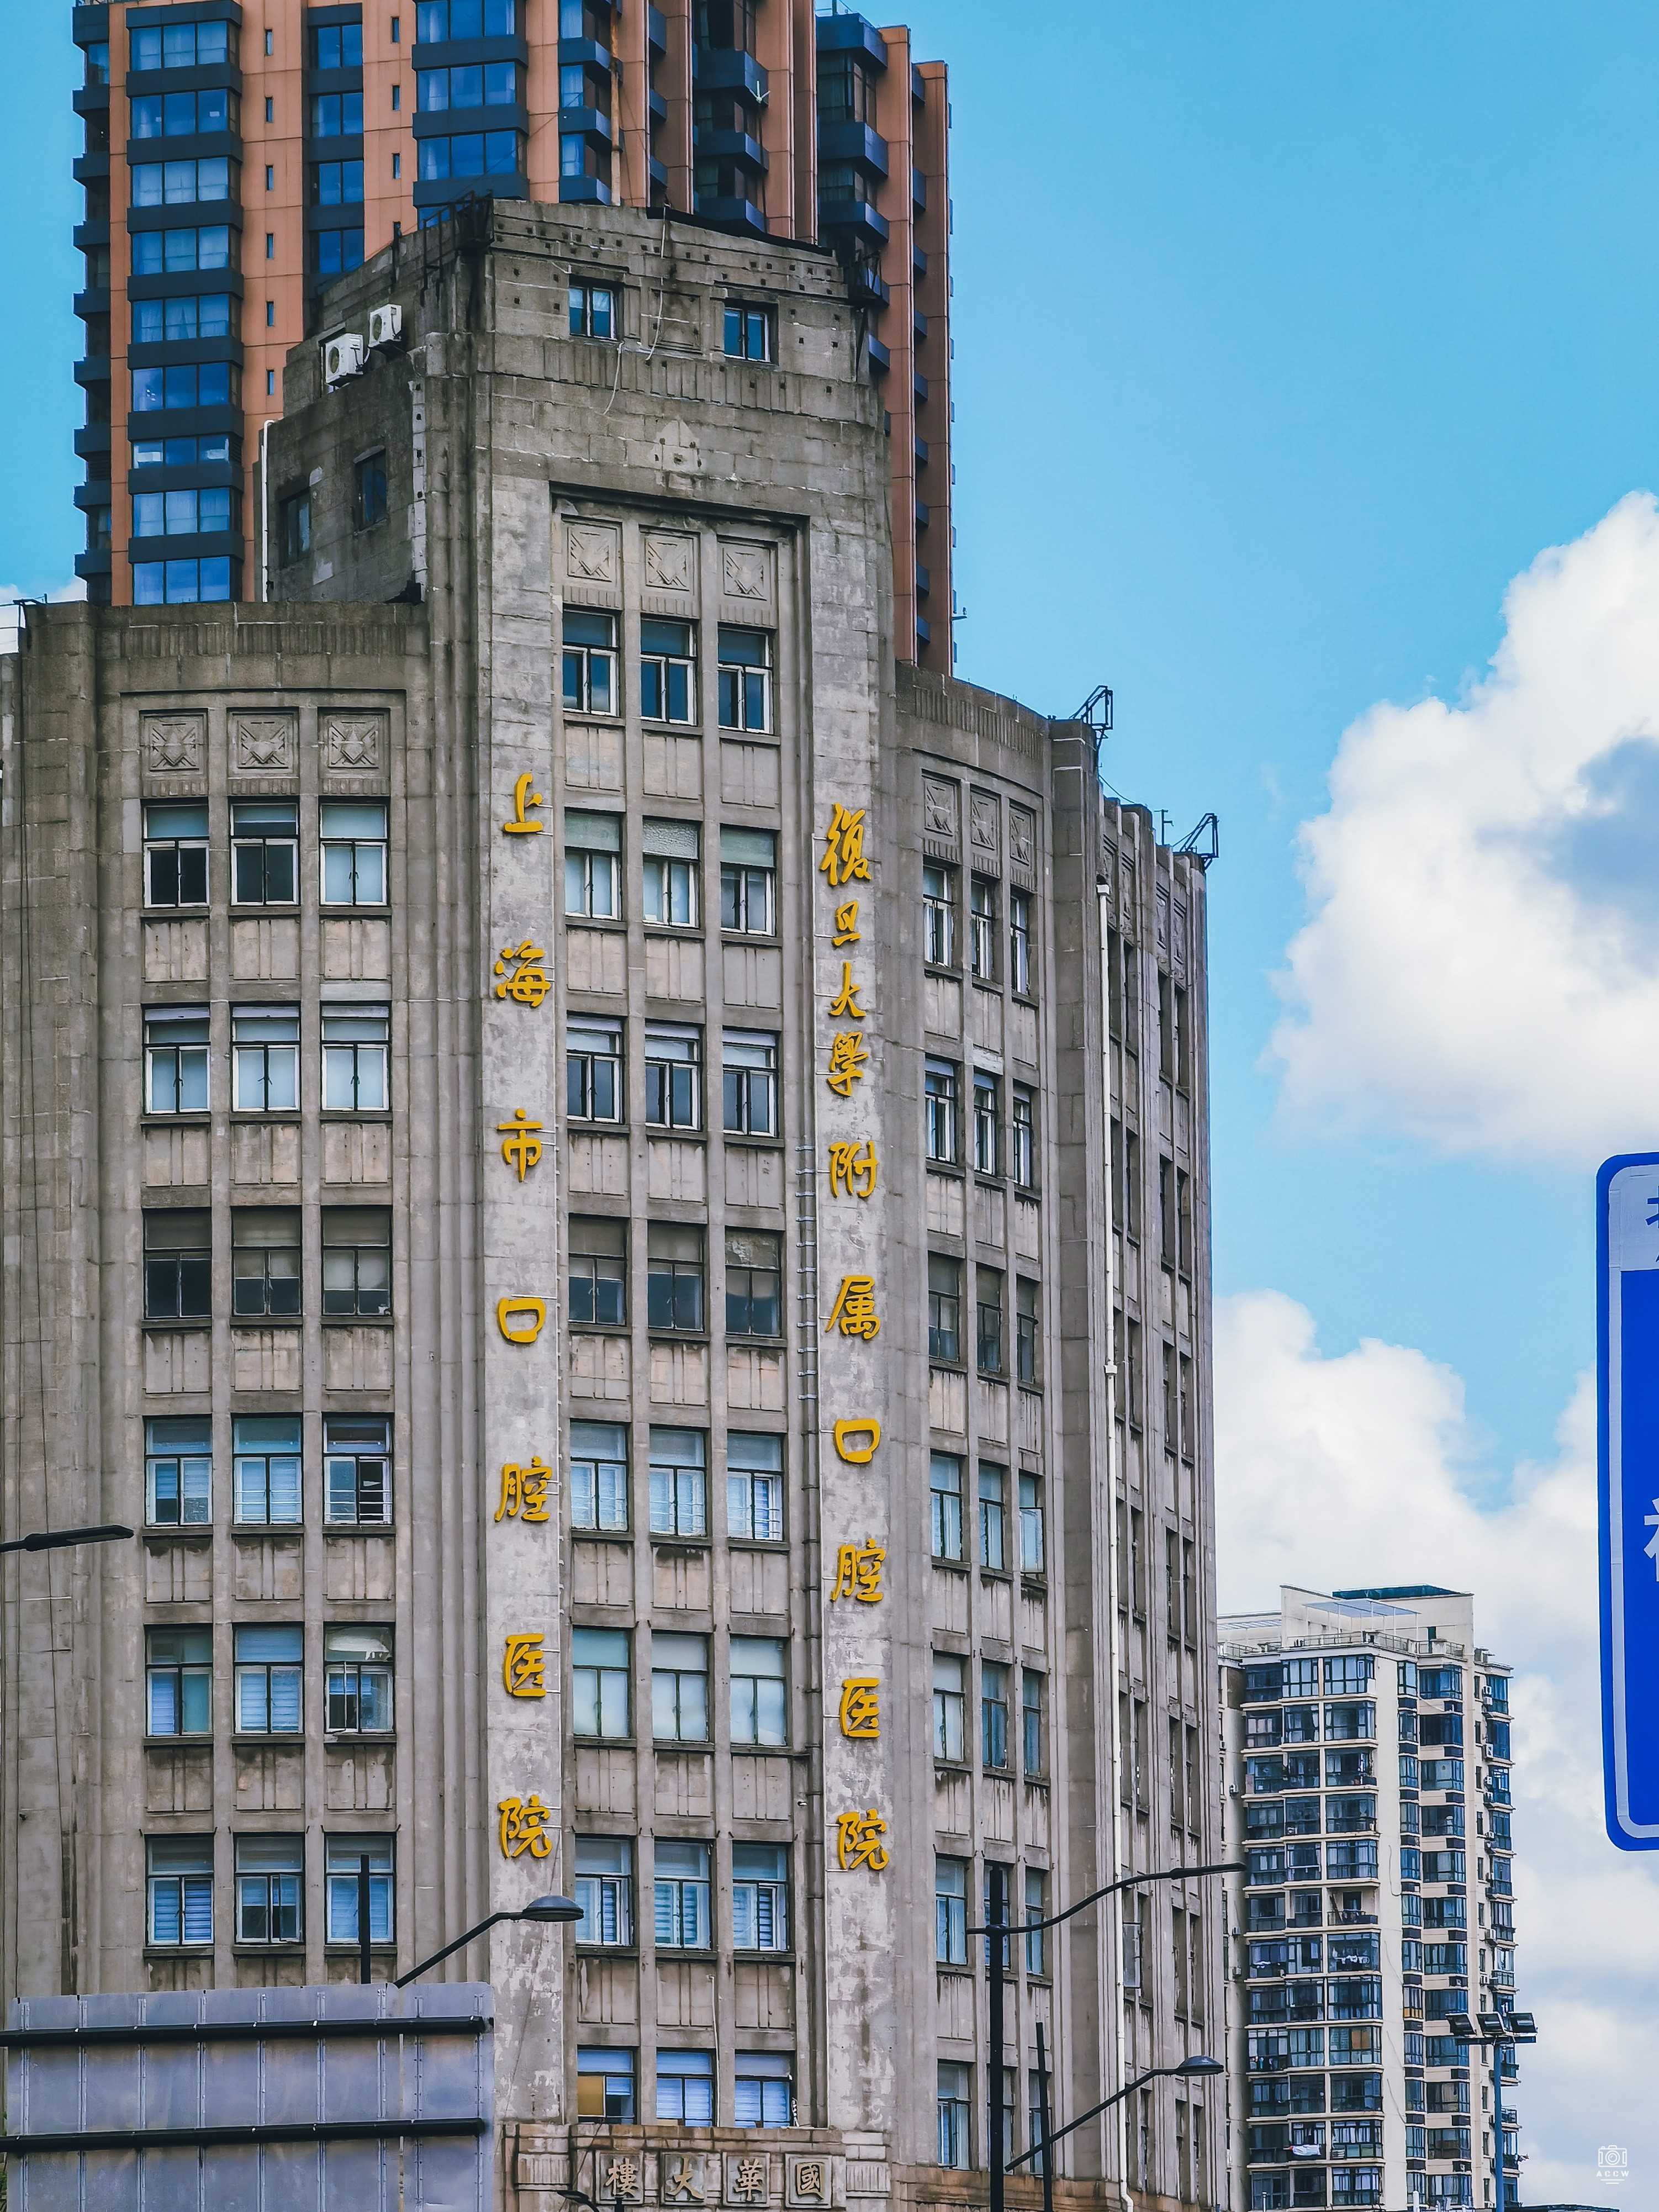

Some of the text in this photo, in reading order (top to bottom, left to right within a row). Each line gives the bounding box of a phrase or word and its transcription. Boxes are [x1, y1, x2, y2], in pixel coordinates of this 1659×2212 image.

[494, 773, 553, 1859] 上海市口腔医院
